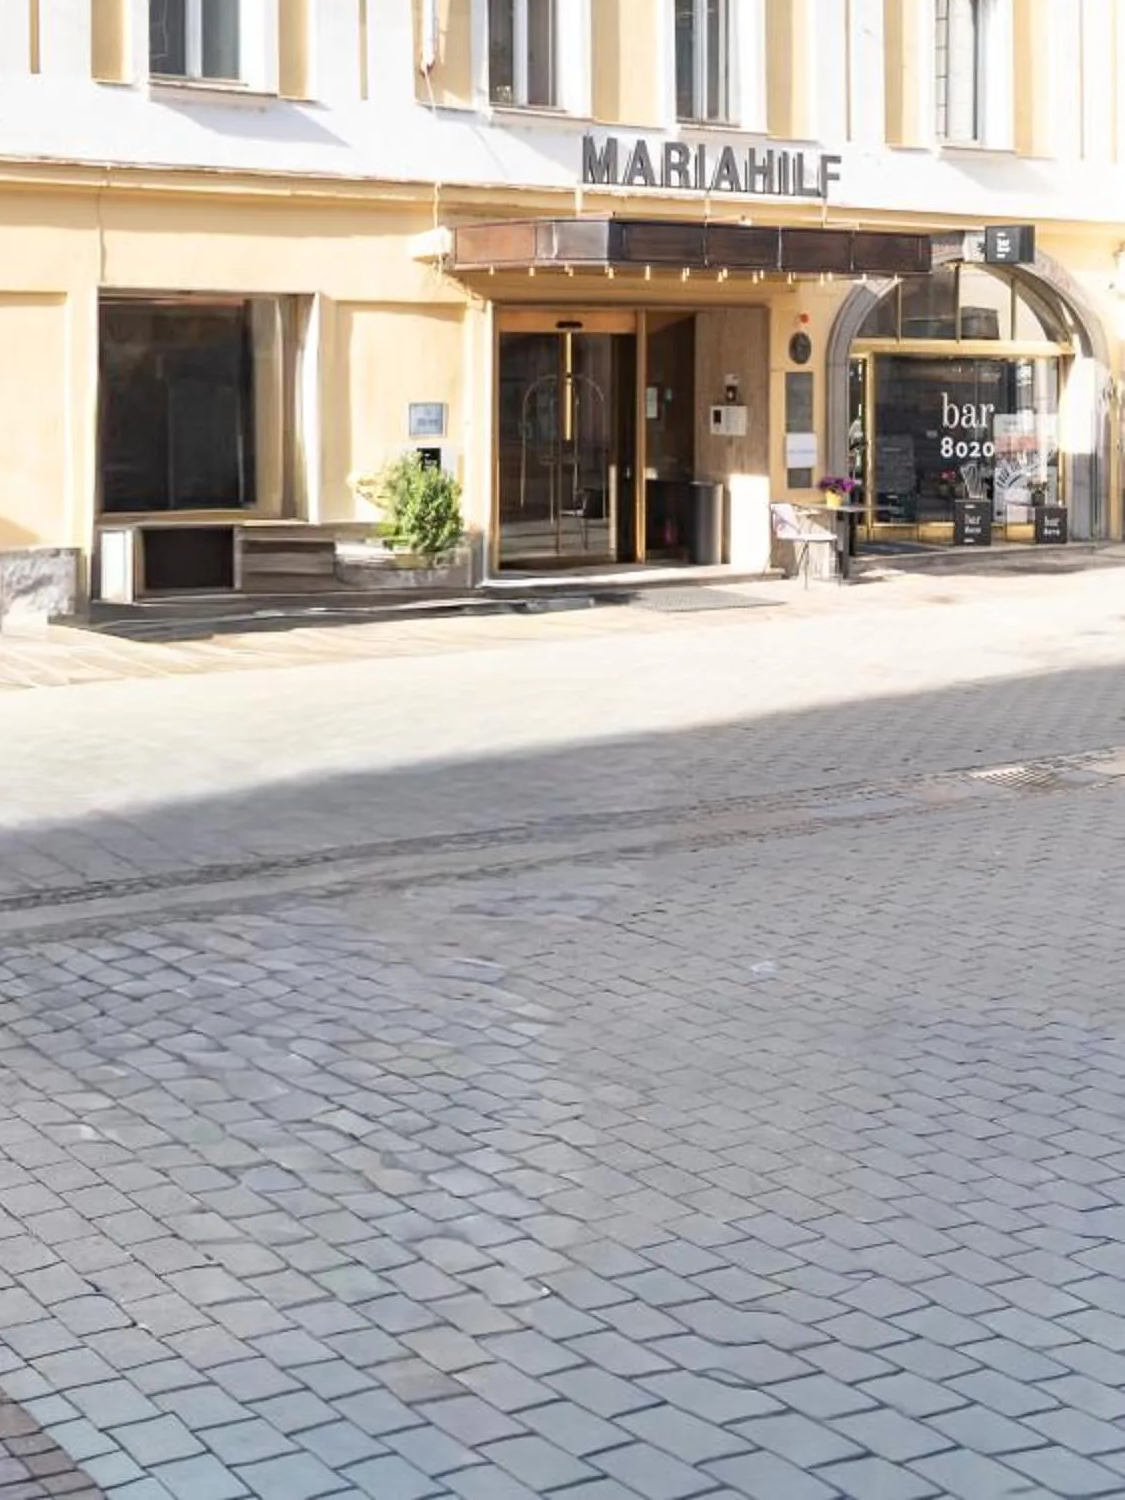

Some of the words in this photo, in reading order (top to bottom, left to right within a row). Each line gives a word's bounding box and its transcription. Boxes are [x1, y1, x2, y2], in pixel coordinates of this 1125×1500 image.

[581, 135, 843, 198] MARIAHILF
[940, 391, 996, 429] bar
[940, 436, 996, 458] 8020
